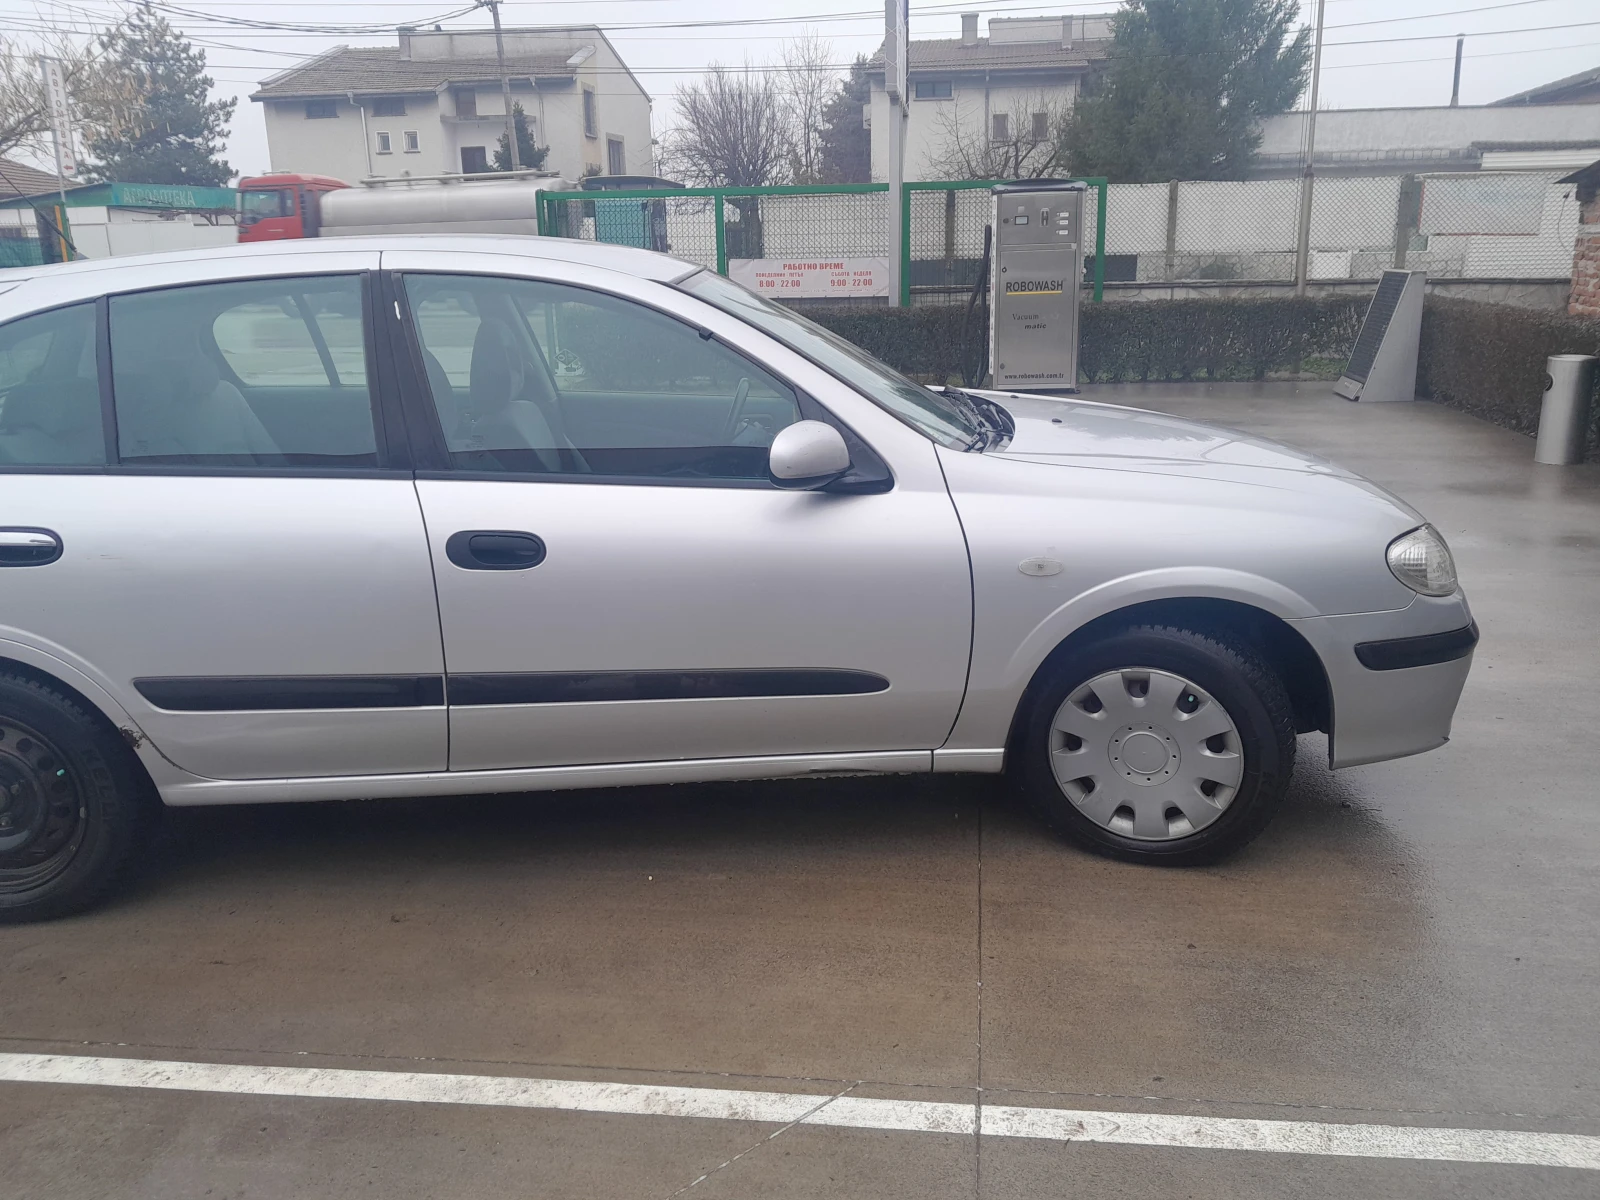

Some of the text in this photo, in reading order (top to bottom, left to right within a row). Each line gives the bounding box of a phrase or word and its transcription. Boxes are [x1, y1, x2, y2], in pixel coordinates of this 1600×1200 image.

[783, 262, 844, 271] РАБОТНО ВРЕМЕ
[759, 279, 775, 287] 8:00
[830, 279, 847, 287] 9:00
[1005, 280, 1064, 293] ROBOWASH
[1012, 313, 1039, 321] Vacuum
[1024, 322, 1047, 330] matic
[1004, 372, 1065, 380] www.robowash.com.tr
